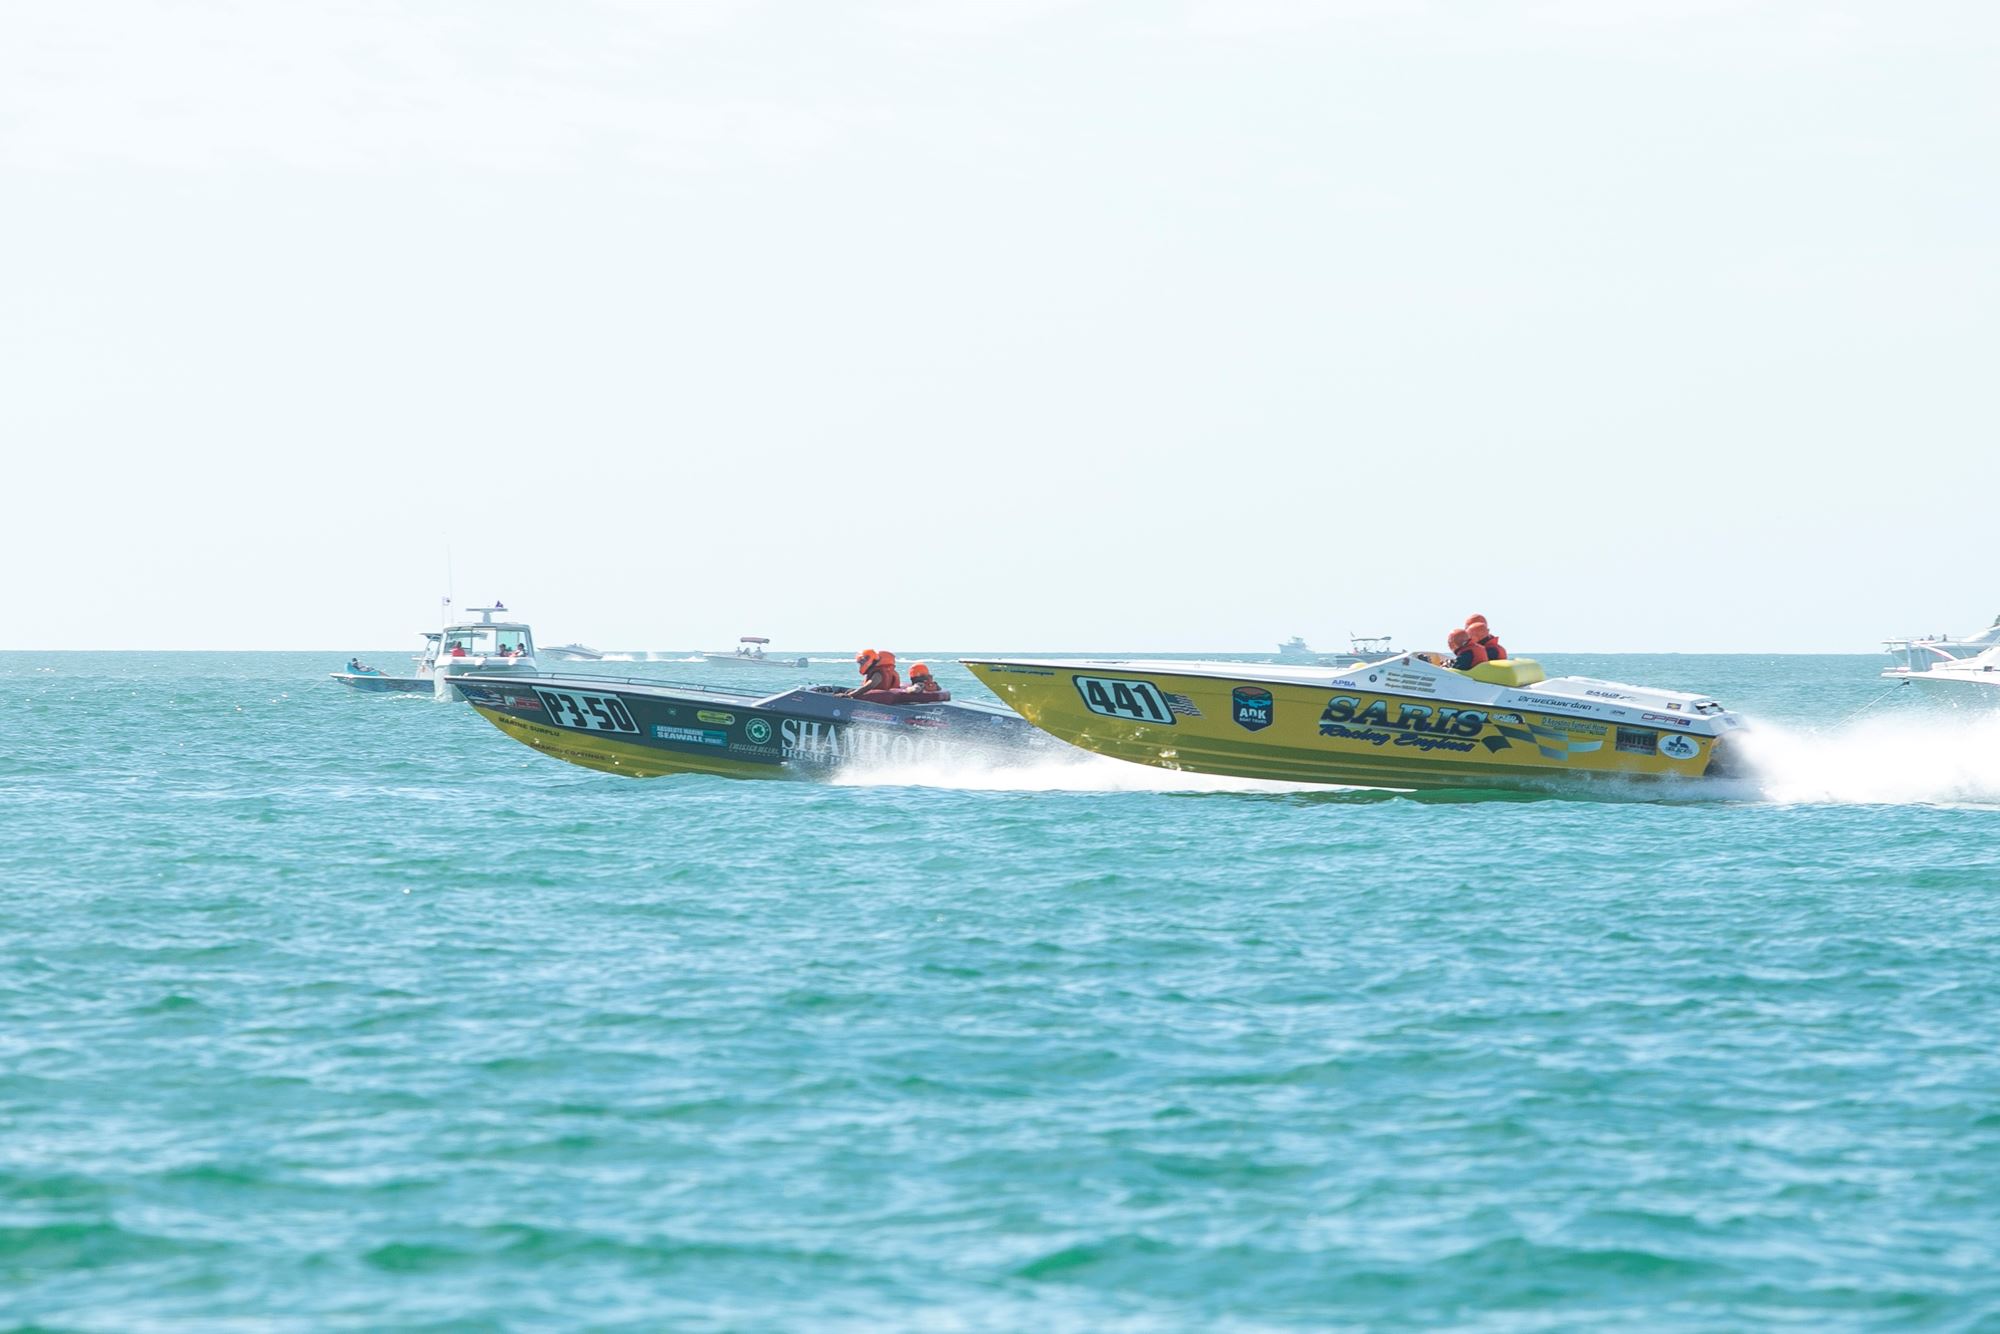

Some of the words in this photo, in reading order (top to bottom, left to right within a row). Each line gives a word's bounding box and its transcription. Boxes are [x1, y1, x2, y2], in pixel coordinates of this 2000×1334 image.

[539, 690, 636, 731] P3-50
[1086, 680, 1164, 720] 441
[1239, 708, 1267, 720] ADK
[1320, 695, 1488, 737] SARIS
[498, 716, 528, 730] MARINE
[656, 731, 704, 743] SEAWALL
[1319, 723, 1392, 746] Racing
[1393, 731, 1477, 751] Engines
[781, 718, 961, 763] SHAMROCK
